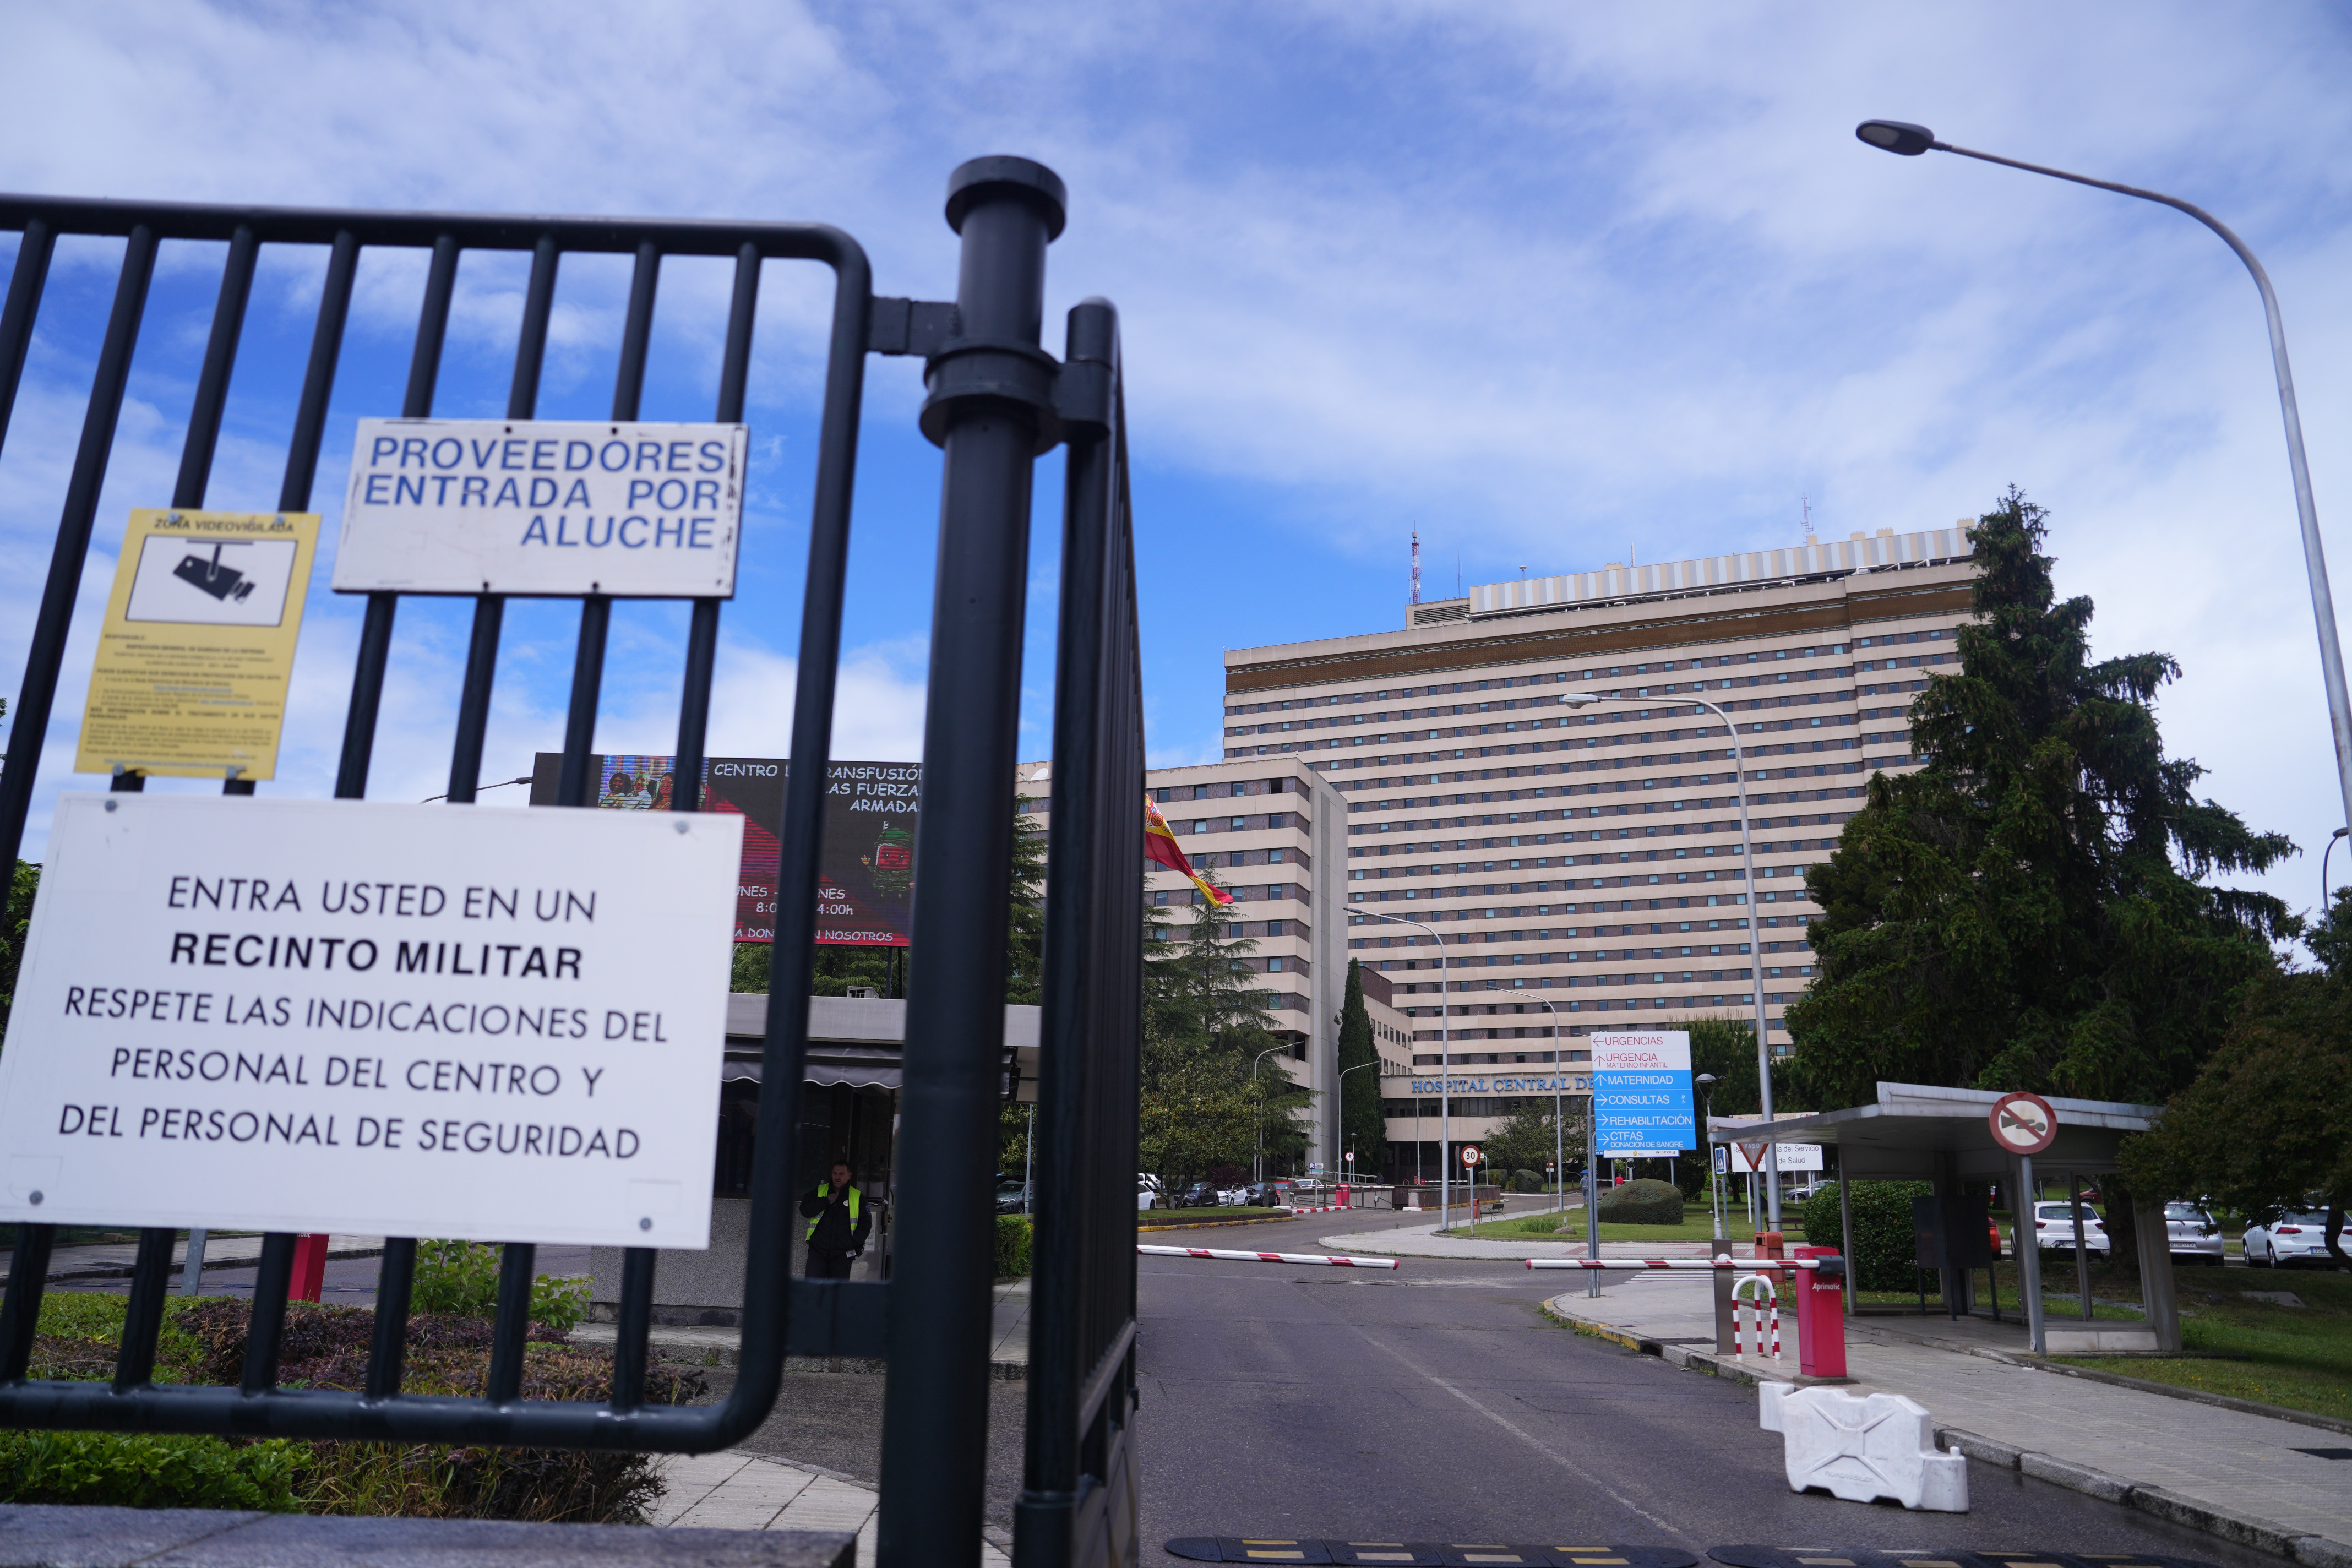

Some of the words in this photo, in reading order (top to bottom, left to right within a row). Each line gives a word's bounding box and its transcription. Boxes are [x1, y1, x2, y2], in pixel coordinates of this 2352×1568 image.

[370, 436, 726, 474] PROVEEDORES
[363, 473, 591, 509] ENTRADA
[627, 478, 721, 511] POR
[521, 515, 716, 550] ALUCHE
[715, 763, 778, 777] CENTRO
[826, 783, 850, 794] AS
[857, 783, 921, 796] FUERZA
[850, 799, 921, 813] ARMADA
[168, 876, 301, 912] ENTRA
[322, 881, 446, 917] USTED
[464, 886, 518, 919] EN
[536, 890, 596, 922] UN
[816, 903, 853, 915] 4:00h
[748, 928, 775, 938] DON
[825, 929, 894, 941] NOSOTROS
[170, 932, 378, 972] RECINTO
[395, 940, 582, 979] MILITAR
[64, 986, 213, 1023] RESPETE
[225, 994, 291, 1027] LAS
[307, 998, 587, 1038] INDICACIONES
[605, 1011, 667, 1042] DEL
[1605, 1036, 1663, 1046] URGENCIAS
[1605, 1053, 1658, 1061] URGENCIA
[111, 1047, 309, 1085] PERSONAL
[325, 1056, 388, 1088] DEL
[406, 1060, 560, 1096] CENTRO
[582, 1068, 603, 1097] Y
[1493, 1078, 1571, 1091] CENTRAL
[1608, 1075, 1673, 1085] MATERNIDAD
[1609, 1095, 1670, 1104] CONSULTAS
[1610, 1113, 1692, 1125] REHABILITACIÓN
[58, 1104, 123, 1137] DEL
[140, 1107, 340, 1146] PERSONAL
[356, 1117, 404, 1148] DE
[418, 1119, 640, 1159] SEGURIDAD
[1610, 1131, 1643, 1141] CTFAS
[1812, 1283, 1840, 1292] Aprimatic
